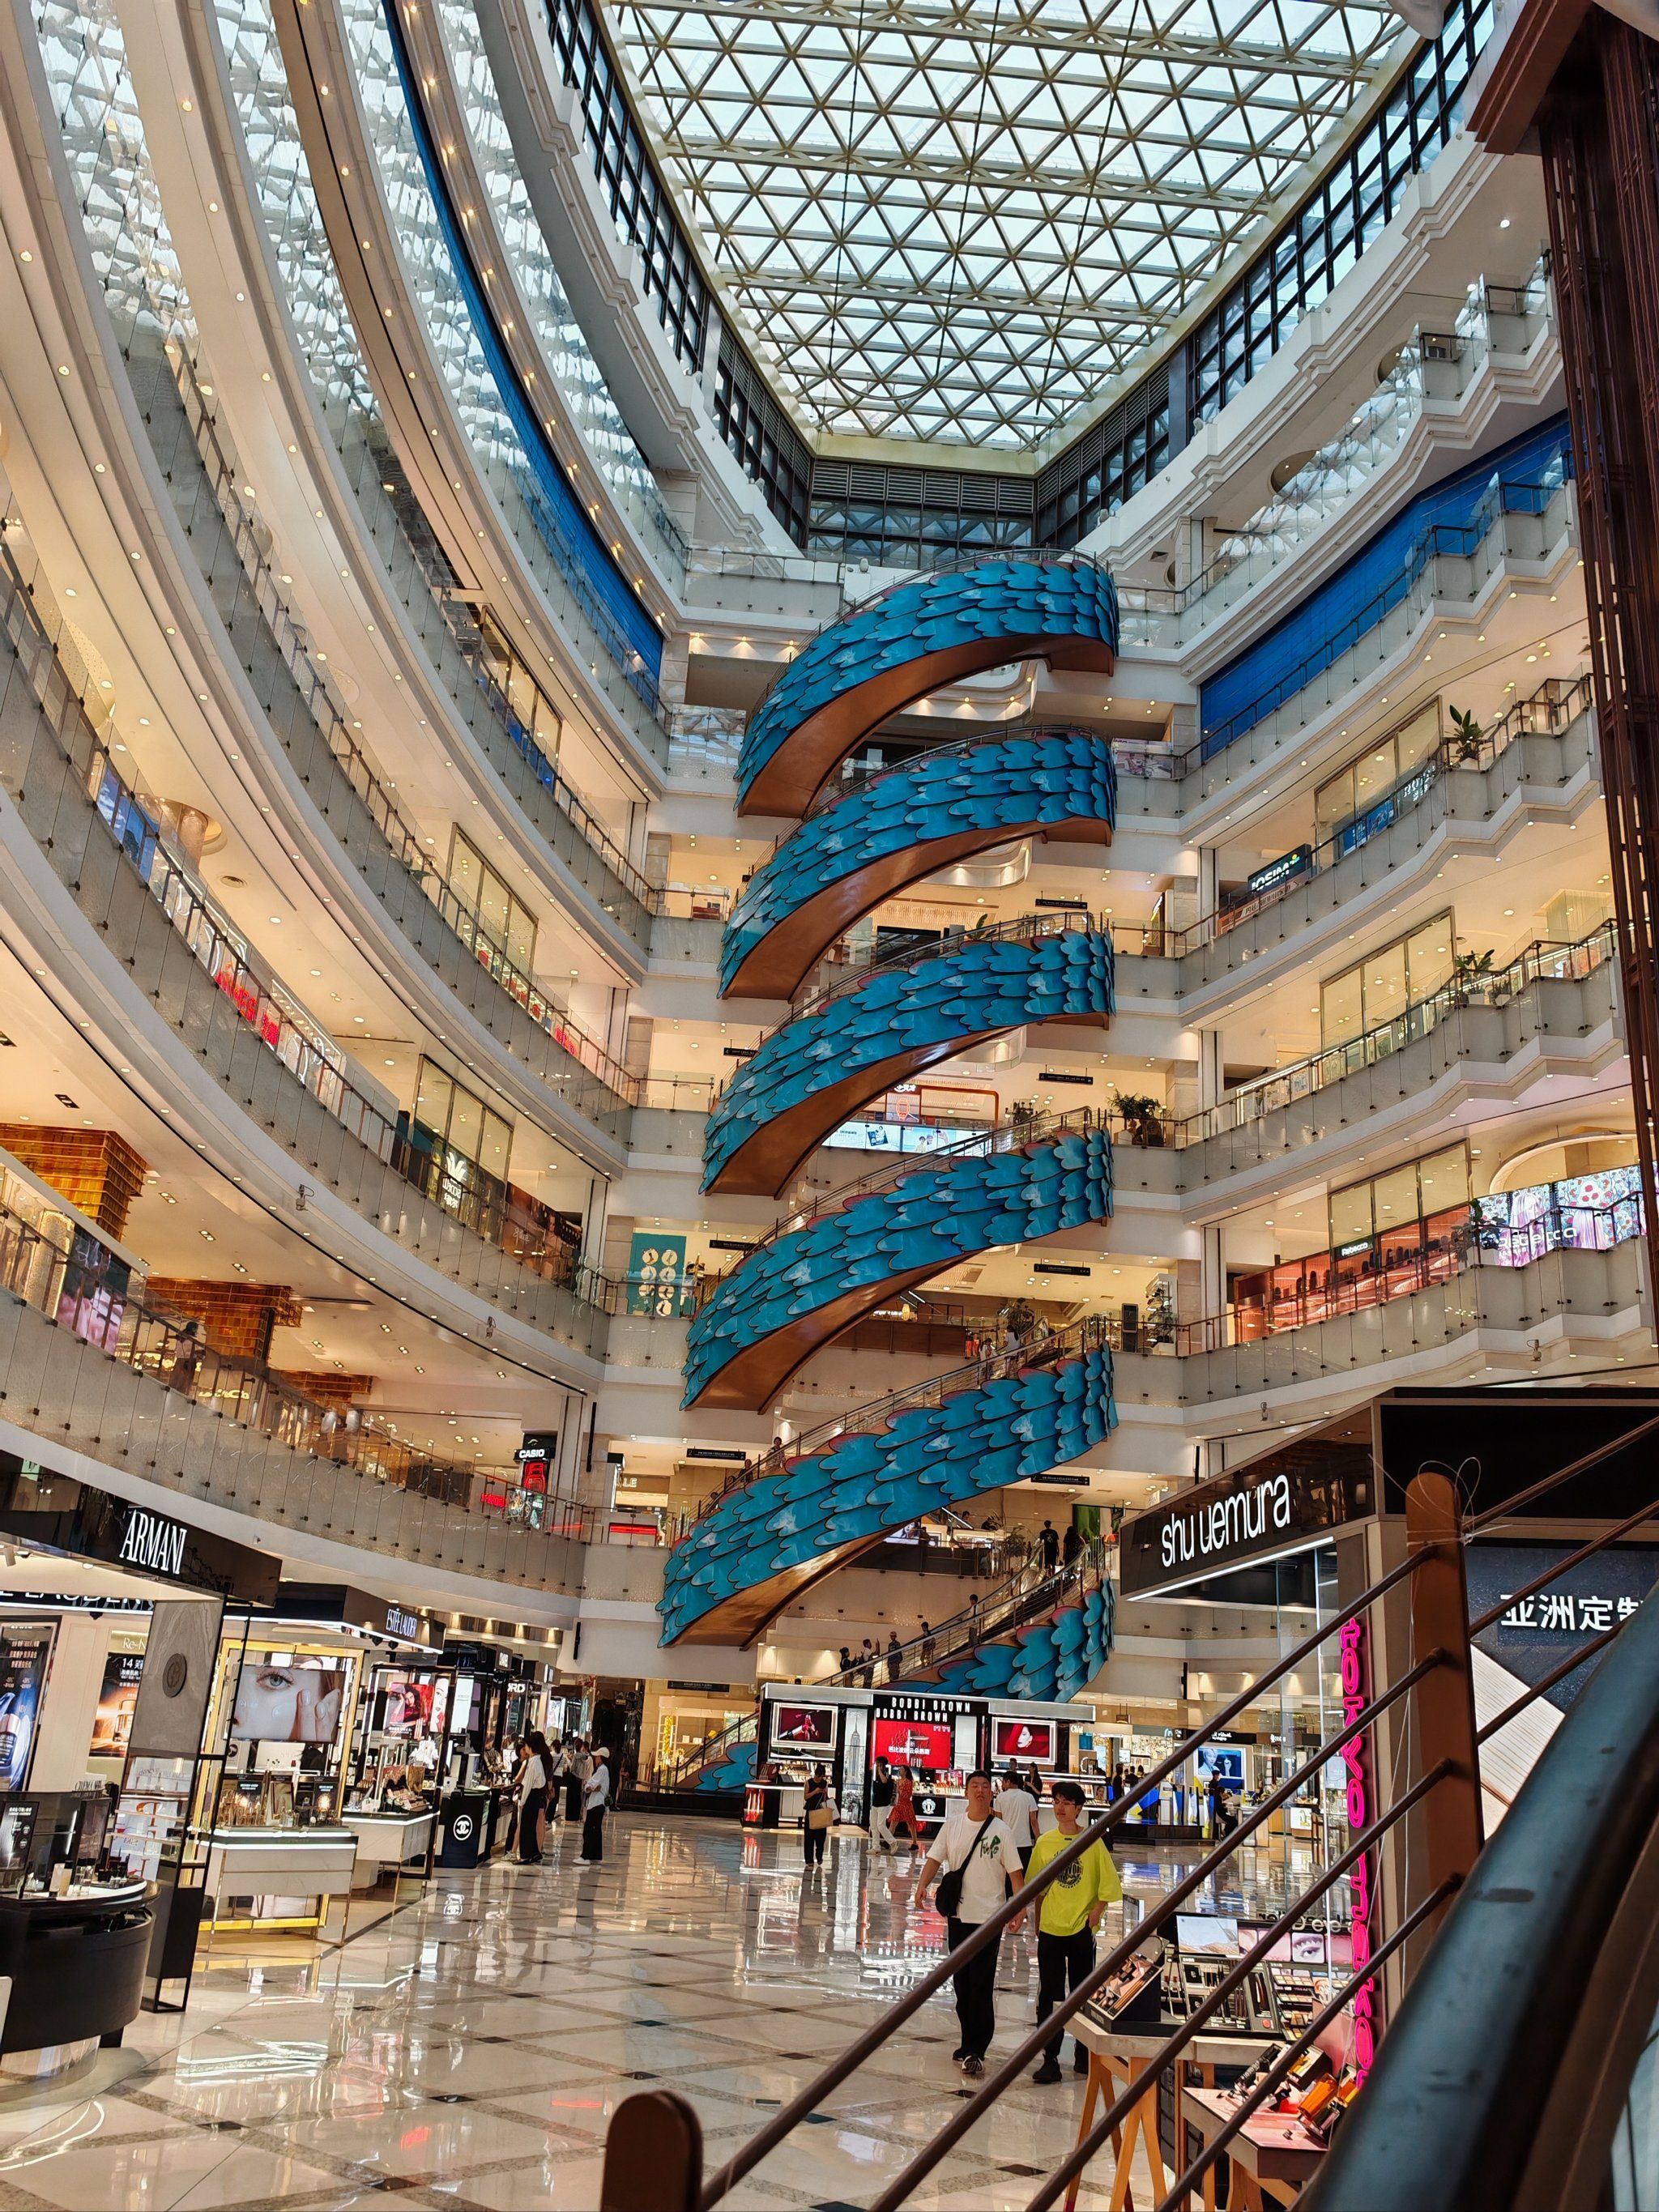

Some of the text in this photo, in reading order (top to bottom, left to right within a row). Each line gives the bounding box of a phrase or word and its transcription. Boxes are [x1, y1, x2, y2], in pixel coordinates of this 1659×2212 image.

[518, 1448, 545, 1459] CASIO
[1162, 1474, 1290, 1567] shu uemura
[119, 1509, 187, 1575] ARMANI
[122, 1657, 134, 1669] 14
[892, 1697, 970, 1713] BOBBI BROWN
[876, 1707, 948, 1723] BOBBI BROWN
